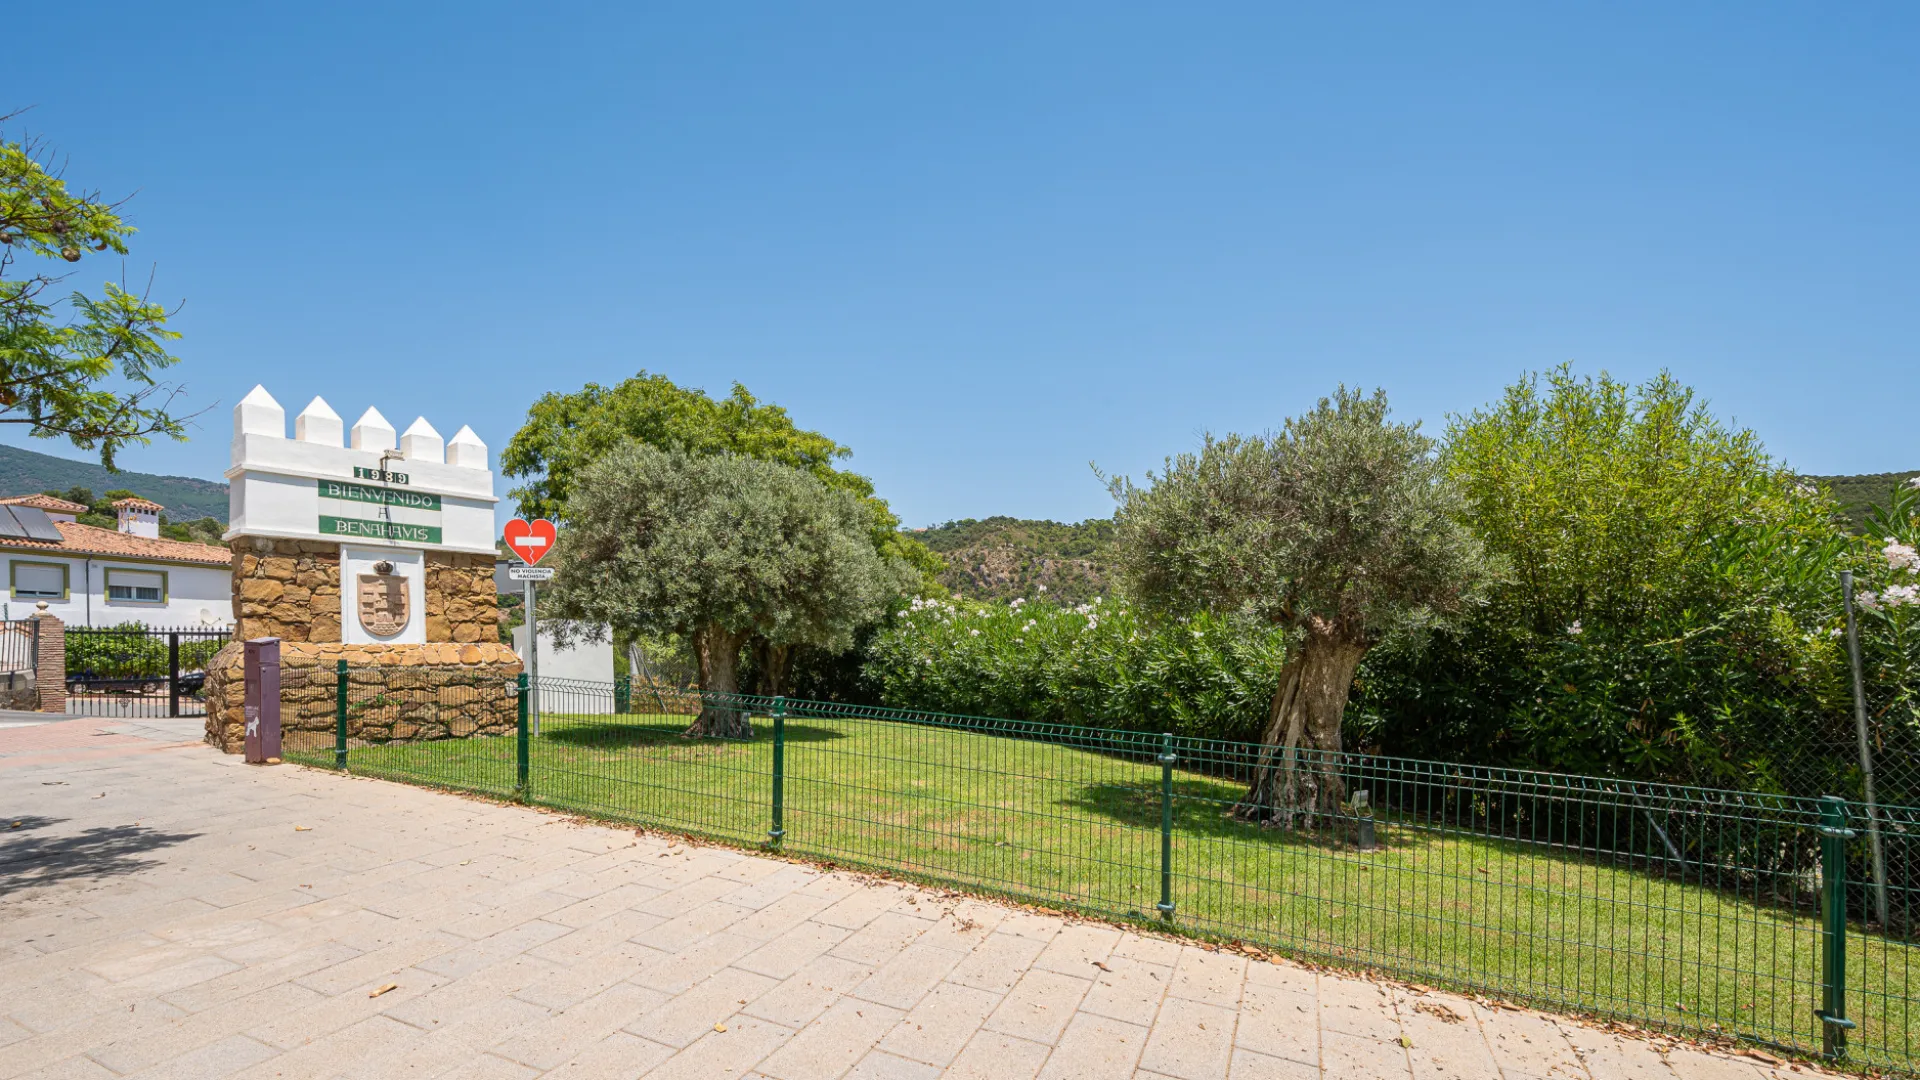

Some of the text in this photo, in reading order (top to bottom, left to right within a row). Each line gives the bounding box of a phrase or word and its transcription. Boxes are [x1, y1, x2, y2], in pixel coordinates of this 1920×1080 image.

[358, 468, 407, 484] 1989
[328, 483, 433, 507] BIENVENIDO
[335, 520, 429, 540] BENAHAVIS
